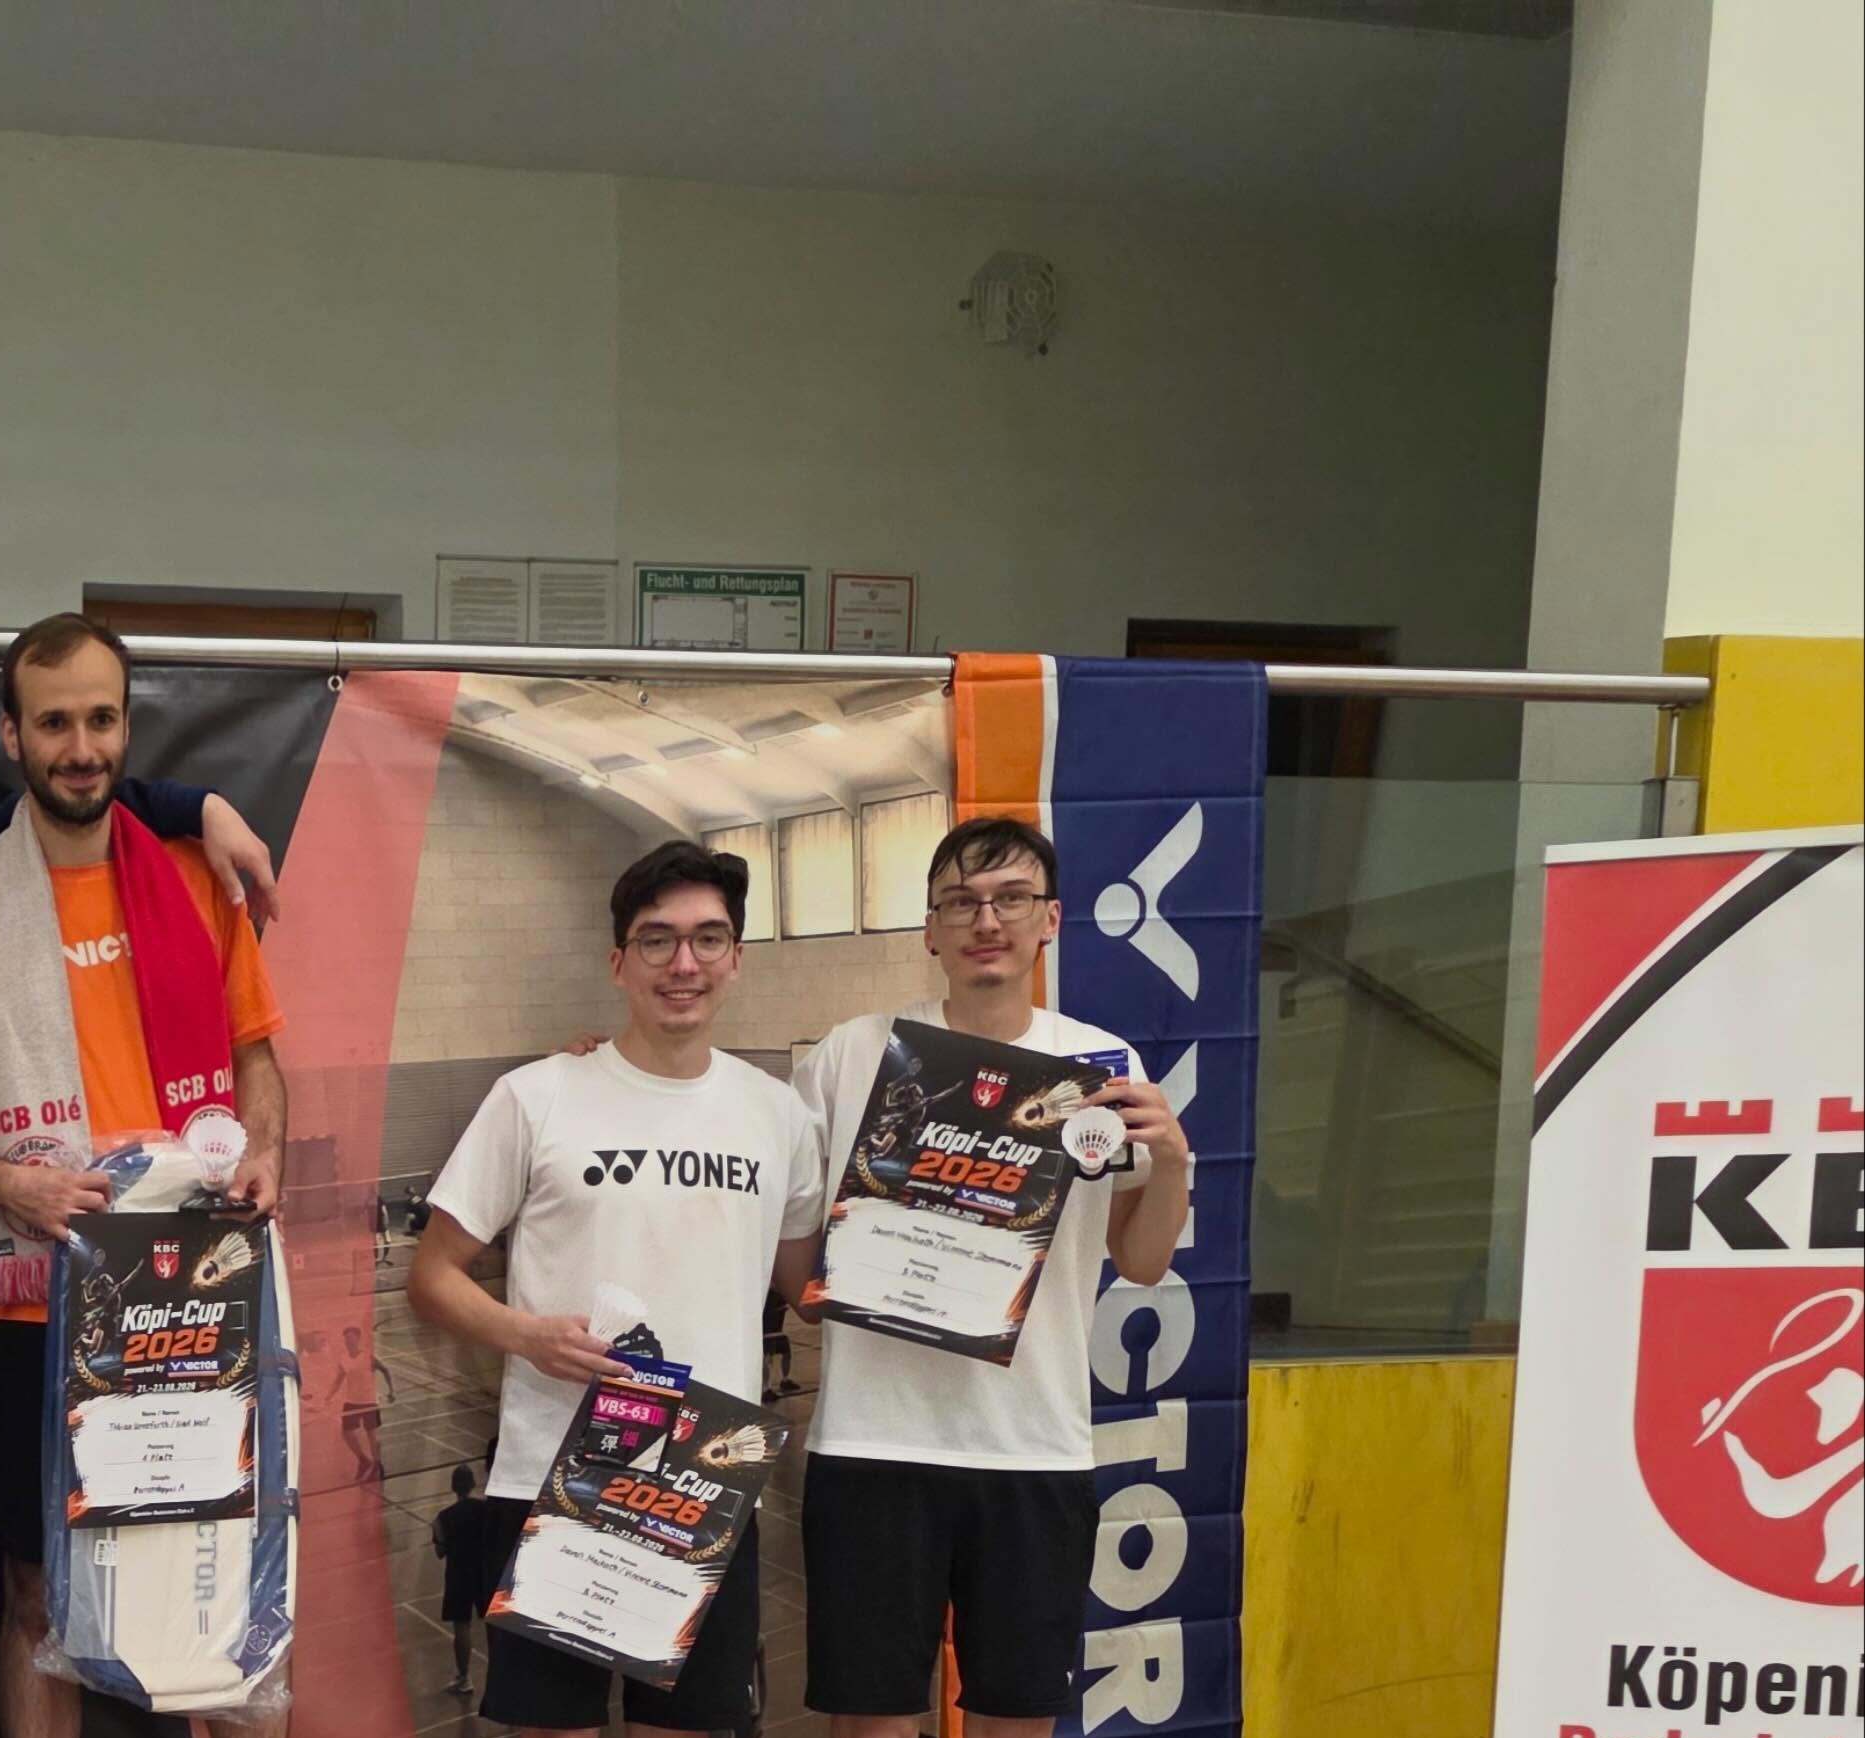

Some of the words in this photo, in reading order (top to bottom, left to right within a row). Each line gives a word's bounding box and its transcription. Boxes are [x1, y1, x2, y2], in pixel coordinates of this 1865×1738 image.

[647, 572, 691, 590] Flucht-
[693, 573, 717, 590] und
[719, 574, 799, 595] Rettungsplan
[62, 933, 132, 968] VIC
[165, 1073, 205, 1106] SCB
[213, 1067, 234, 1095] Ol
[41, 1095, 81, 1125] Olé
[918, 1121, 1043, 1168] Köpi-Cup
[656, 1149, 760, 1195] YONEX
[910, 1151, 1027, 1194] 2026
[153, 1245, 179, 1253] KBC
[121, 1300, 226, 1334] Köpi-Cup
[123, 1327, 220, 1363] 2026
[182, 1360, 218, 1371] VICTOR
[1082, 1040, 1198, 1737] CTOR
[597, 1396, 651, 1421] VBS-63
[600, 1476, 708, 1526] 2026
[660, 1462, 724, 1503] i-Cup
[194, 1521, 217, 1603] CTOR
